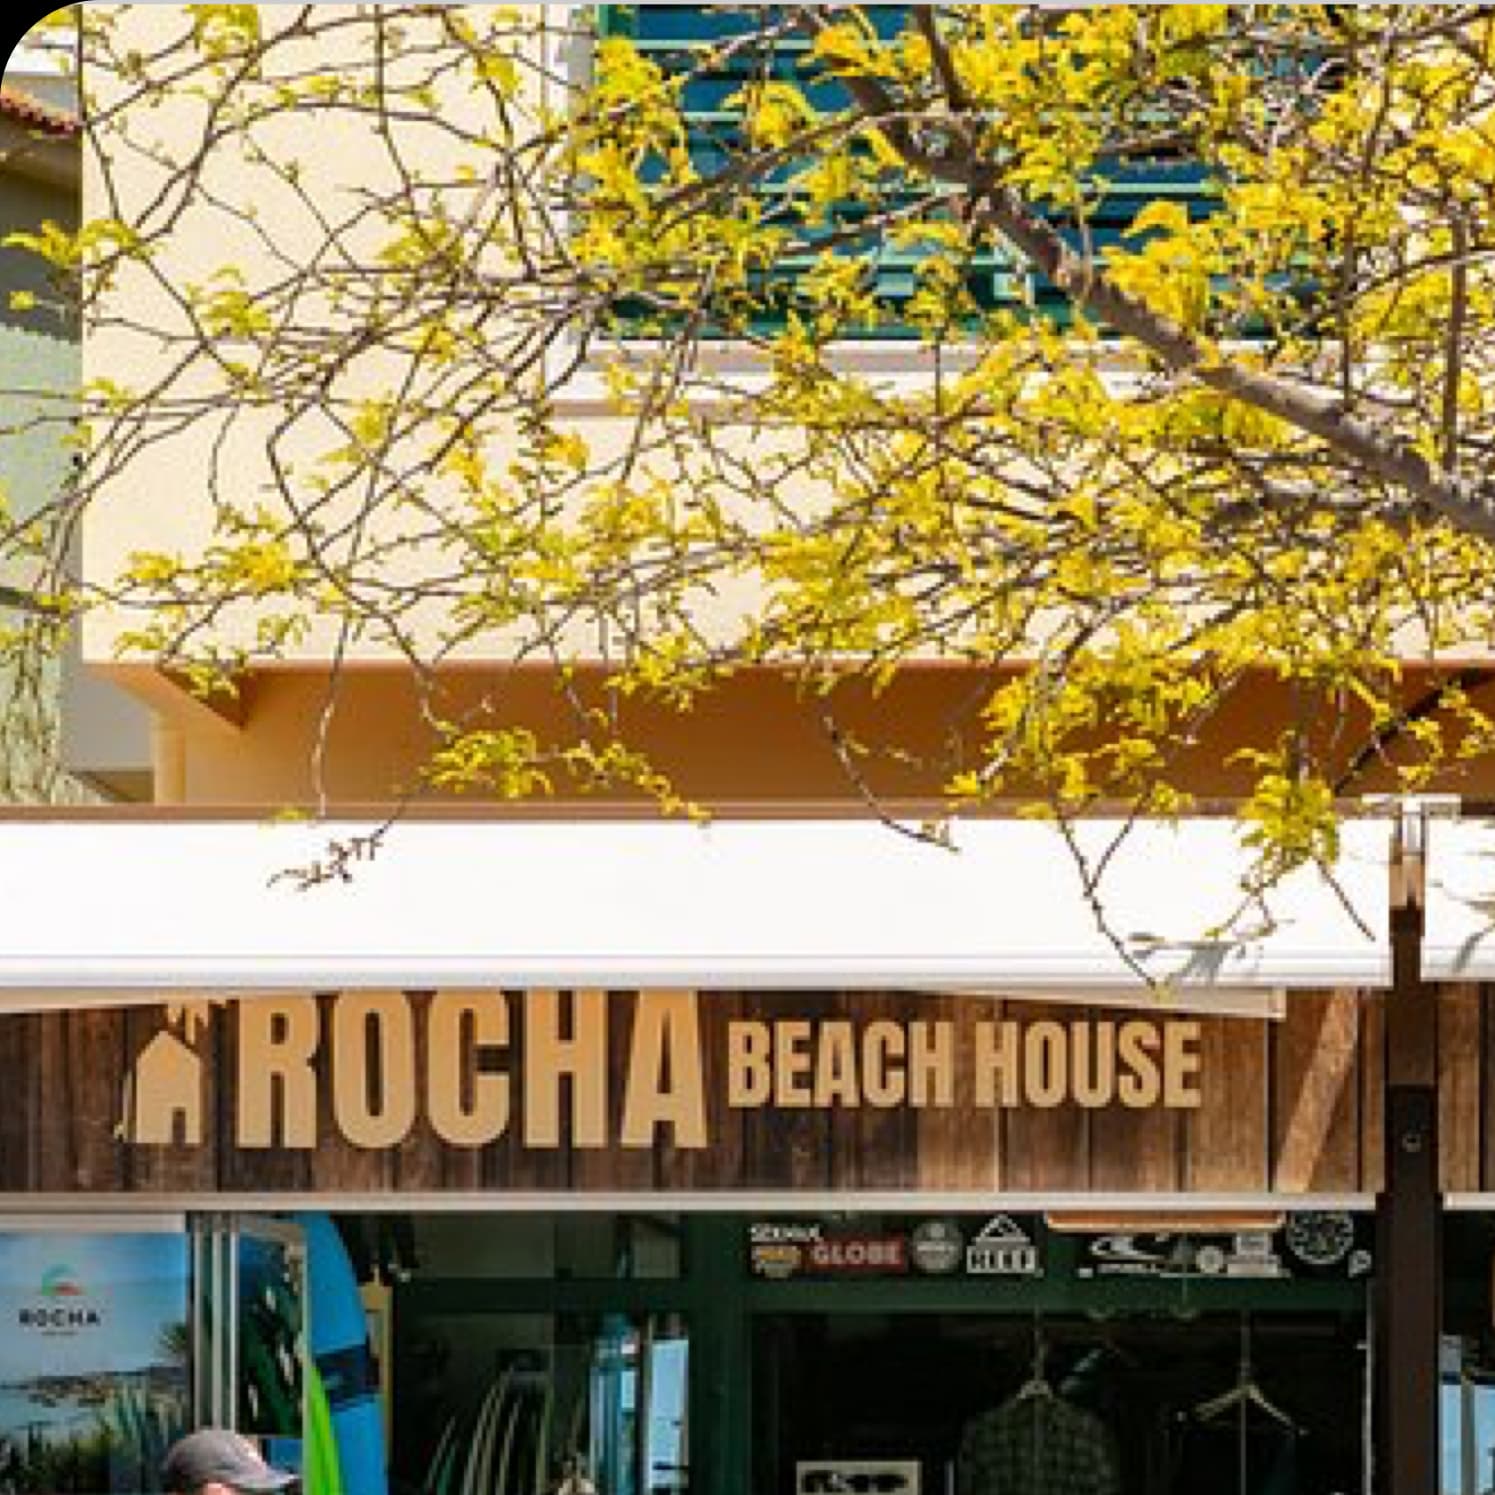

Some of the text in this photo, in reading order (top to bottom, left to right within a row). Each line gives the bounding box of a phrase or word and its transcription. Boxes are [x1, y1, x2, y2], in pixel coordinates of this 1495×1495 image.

[237, 990, 708, 1149] ROCHA
[727, 1020, 1202, 1108] BEACH HOUSE
[811, 1242, 902, 1266] GLOBE
